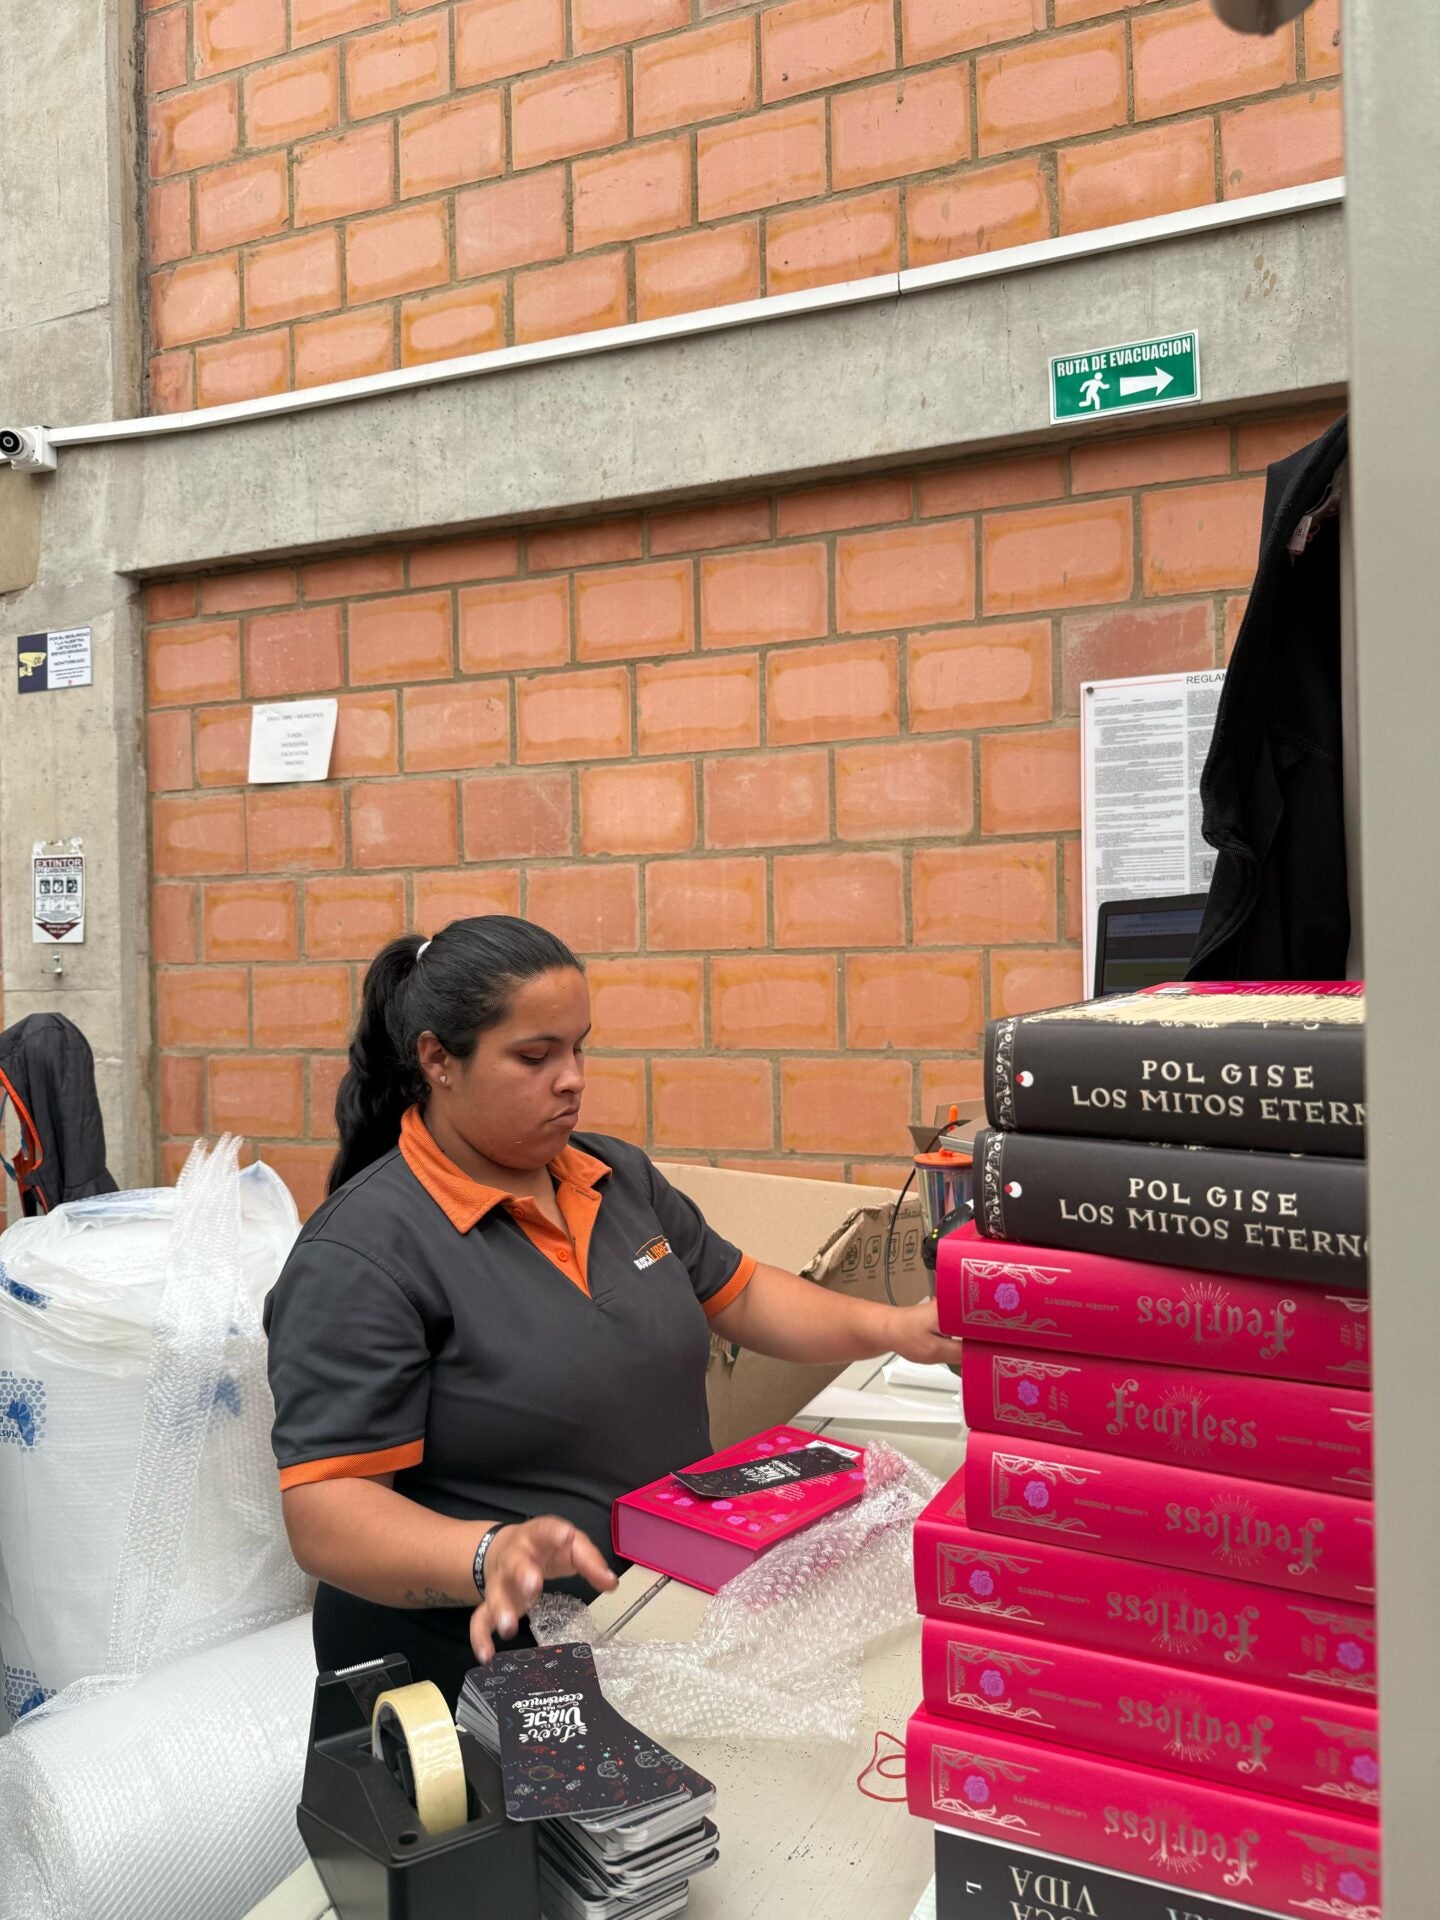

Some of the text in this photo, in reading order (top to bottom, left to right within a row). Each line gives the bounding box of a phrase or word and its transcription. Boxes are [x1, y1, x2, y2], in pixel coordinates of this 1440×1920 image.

[1056, 337, 1191, 377] RUTA DE EVACUACION
[36, 859, 82, 868] EXTINTOR
[1142, 1060, 1315, 1089] POL GISE
[1070, 1085, 1127, 1109] LOS
[1139, 1089, 1245, 1117] MITOS
[1128, 1177, 1298, 1217] POL GISE
[1058, 1199, 1369, 1258] LOS MITOS ETERN
[512, 1692, 584, 1709] económico
[522, 1706, 586, 1728] VIAJE
[527, 1724, 577, 1743] Leer
[1008, 1865, 1099, 1918] VIDA
